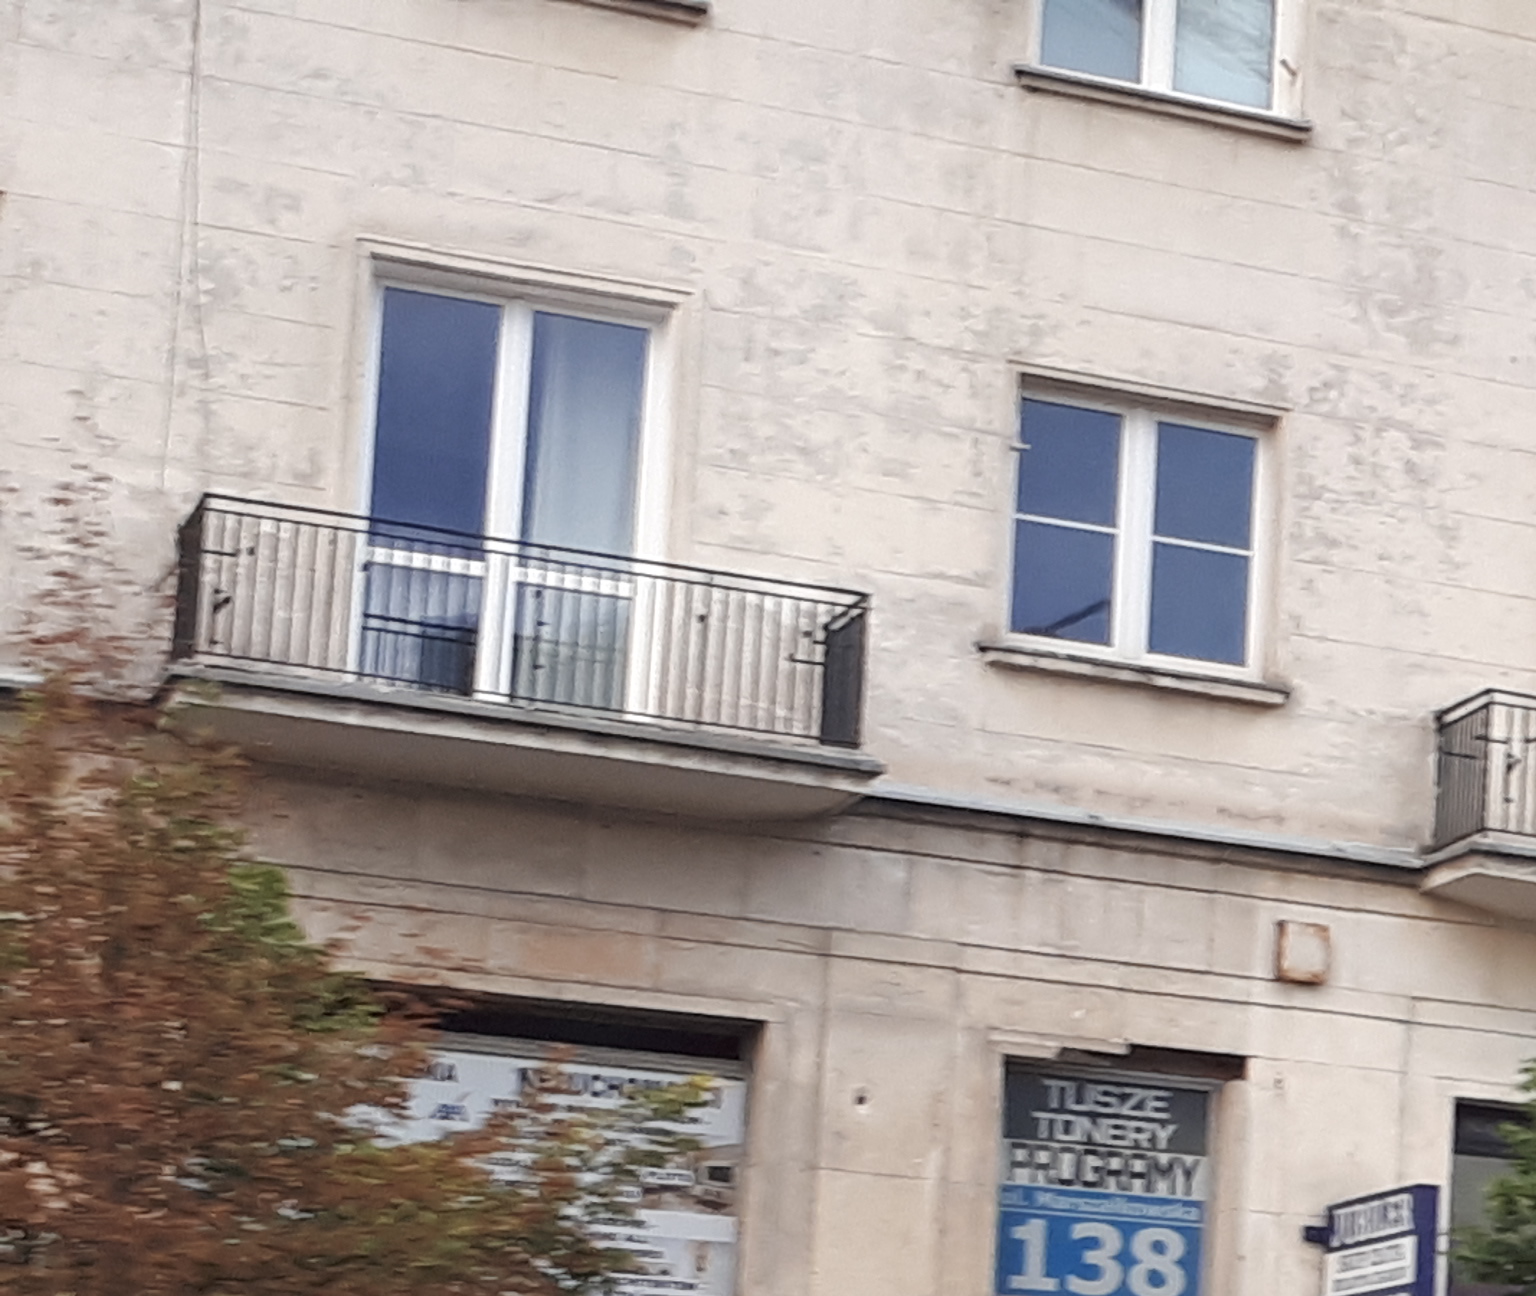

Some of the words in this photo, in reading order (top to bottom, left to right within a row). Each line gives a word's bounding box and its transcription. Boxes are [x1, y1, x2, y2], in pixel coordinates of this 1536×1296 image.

[1041, 1077, 1174, 1120] TUSZE
[1030, 1110, 1180, 1150] TONERY
[1008, 1141, 1204, 1197] PROGRAMY
